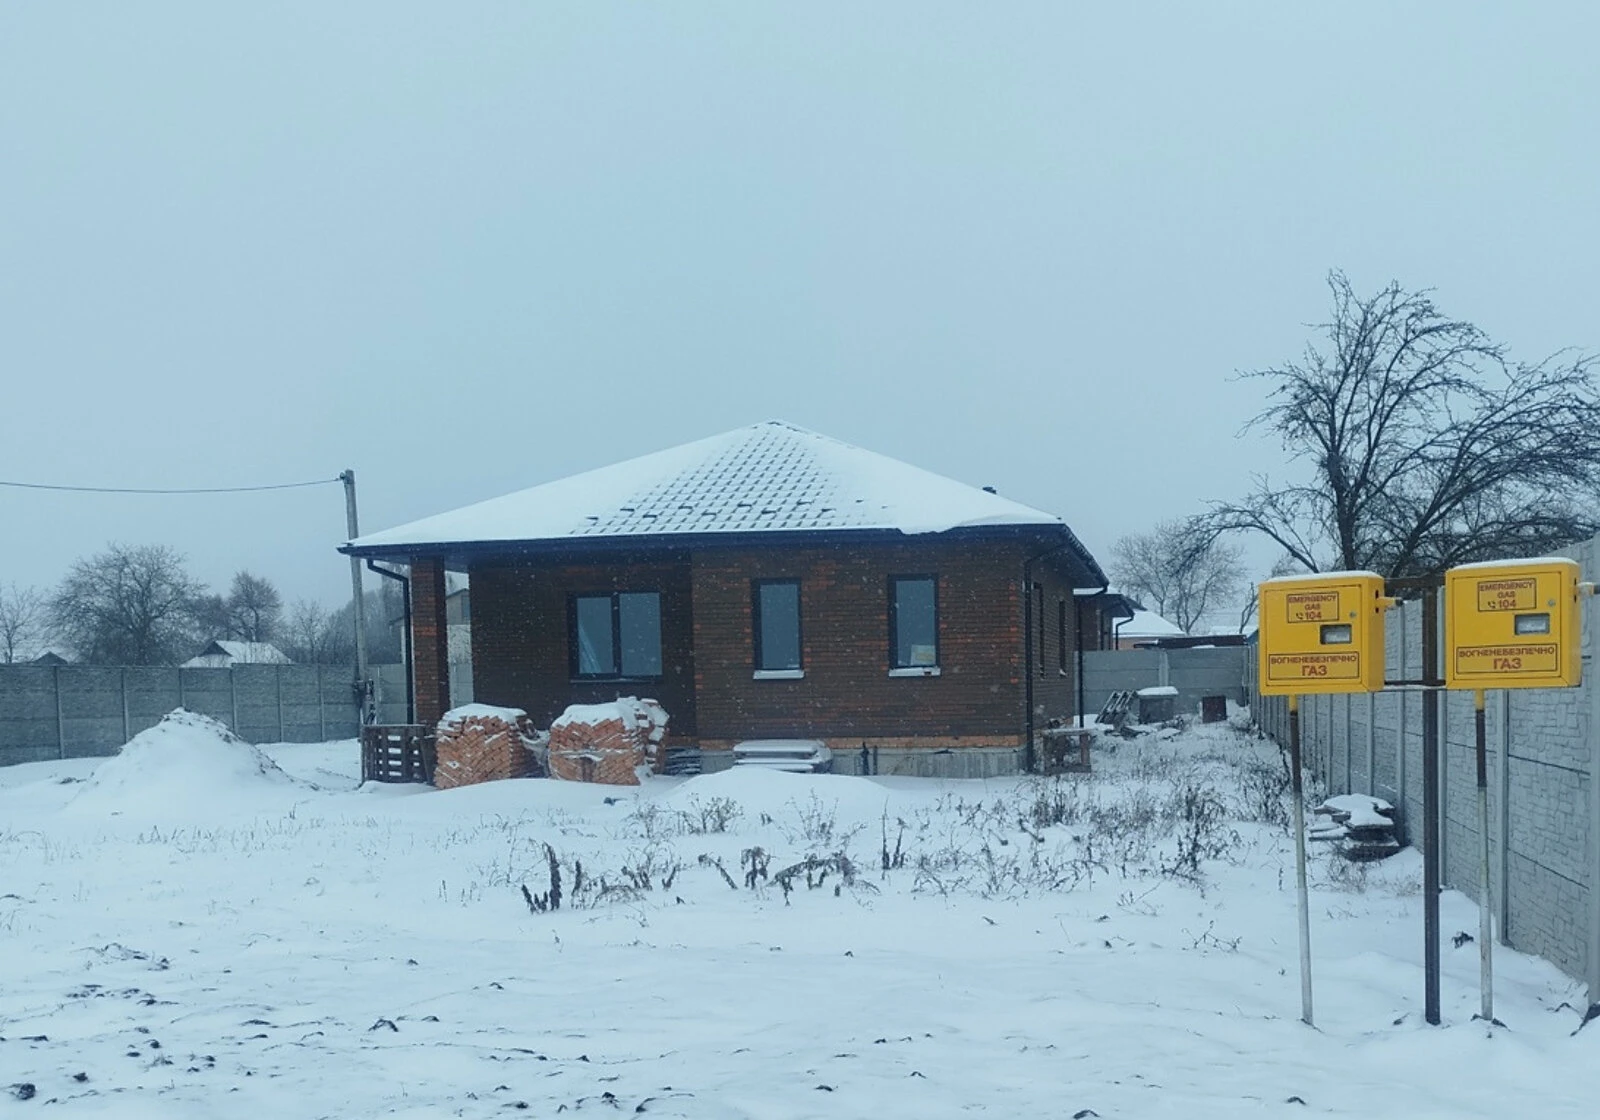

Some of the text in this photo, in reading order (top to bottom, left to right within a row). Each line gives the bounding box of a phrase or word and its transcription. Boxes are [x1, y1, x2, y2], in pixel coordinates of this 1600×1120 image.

[1479, 582, 1533, 591] EMERGENCY
[1497, 591, 1515, 599] GAS
[1288, 595, 1336, 604] EMERGENCY
[1304, 603, 1321, 611] GAS
[1498, 600, 1516, 608] 104
[1305, 612, 1322, 620] 104
[1459, 647, 1554, 657] ВОГНЕНЕБЕЗПЕЧНО
[1271, 656, 1356, 664] ВОГНЕНЕБЕЗПЕЧНО
[1493, 658, 1522, 670] ГАЗ
[1302, 665, 1328, 676] ГАЗ
